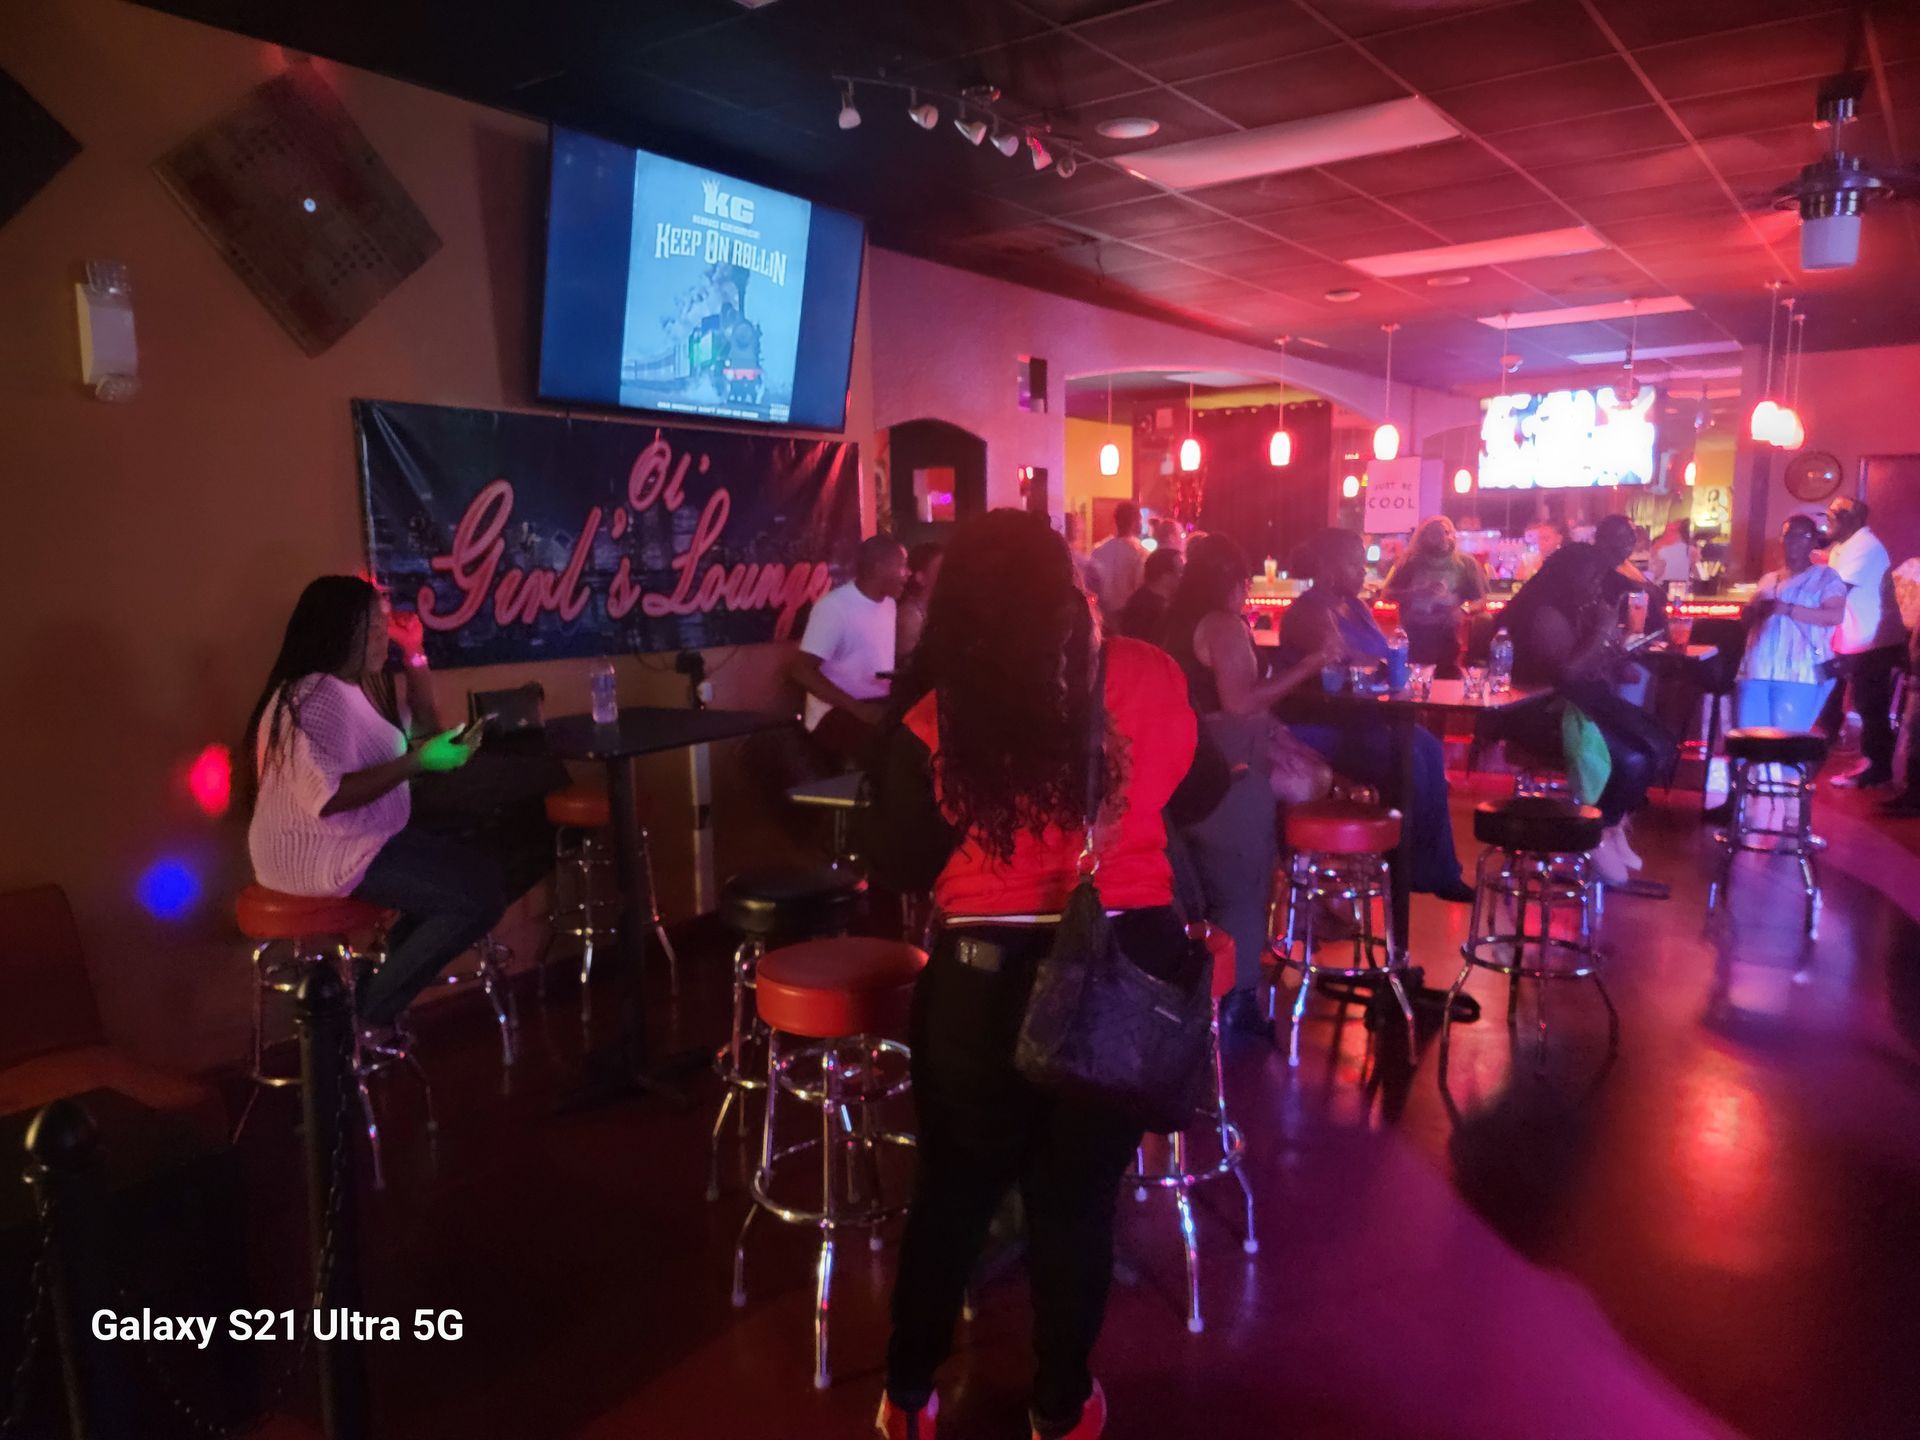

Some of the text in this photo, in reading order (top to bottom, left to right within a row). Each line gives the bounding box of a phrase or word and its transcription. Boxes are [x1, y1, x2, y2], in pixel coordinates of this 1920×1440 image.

[655, 223, 702, 258] KEEP
[704, 229, 730, 264] ON
[732, 239, 787, 287] ROLLIN
[1368, 497, 1415, 509] COOL
[642, 488, 832, 641] Lounge
